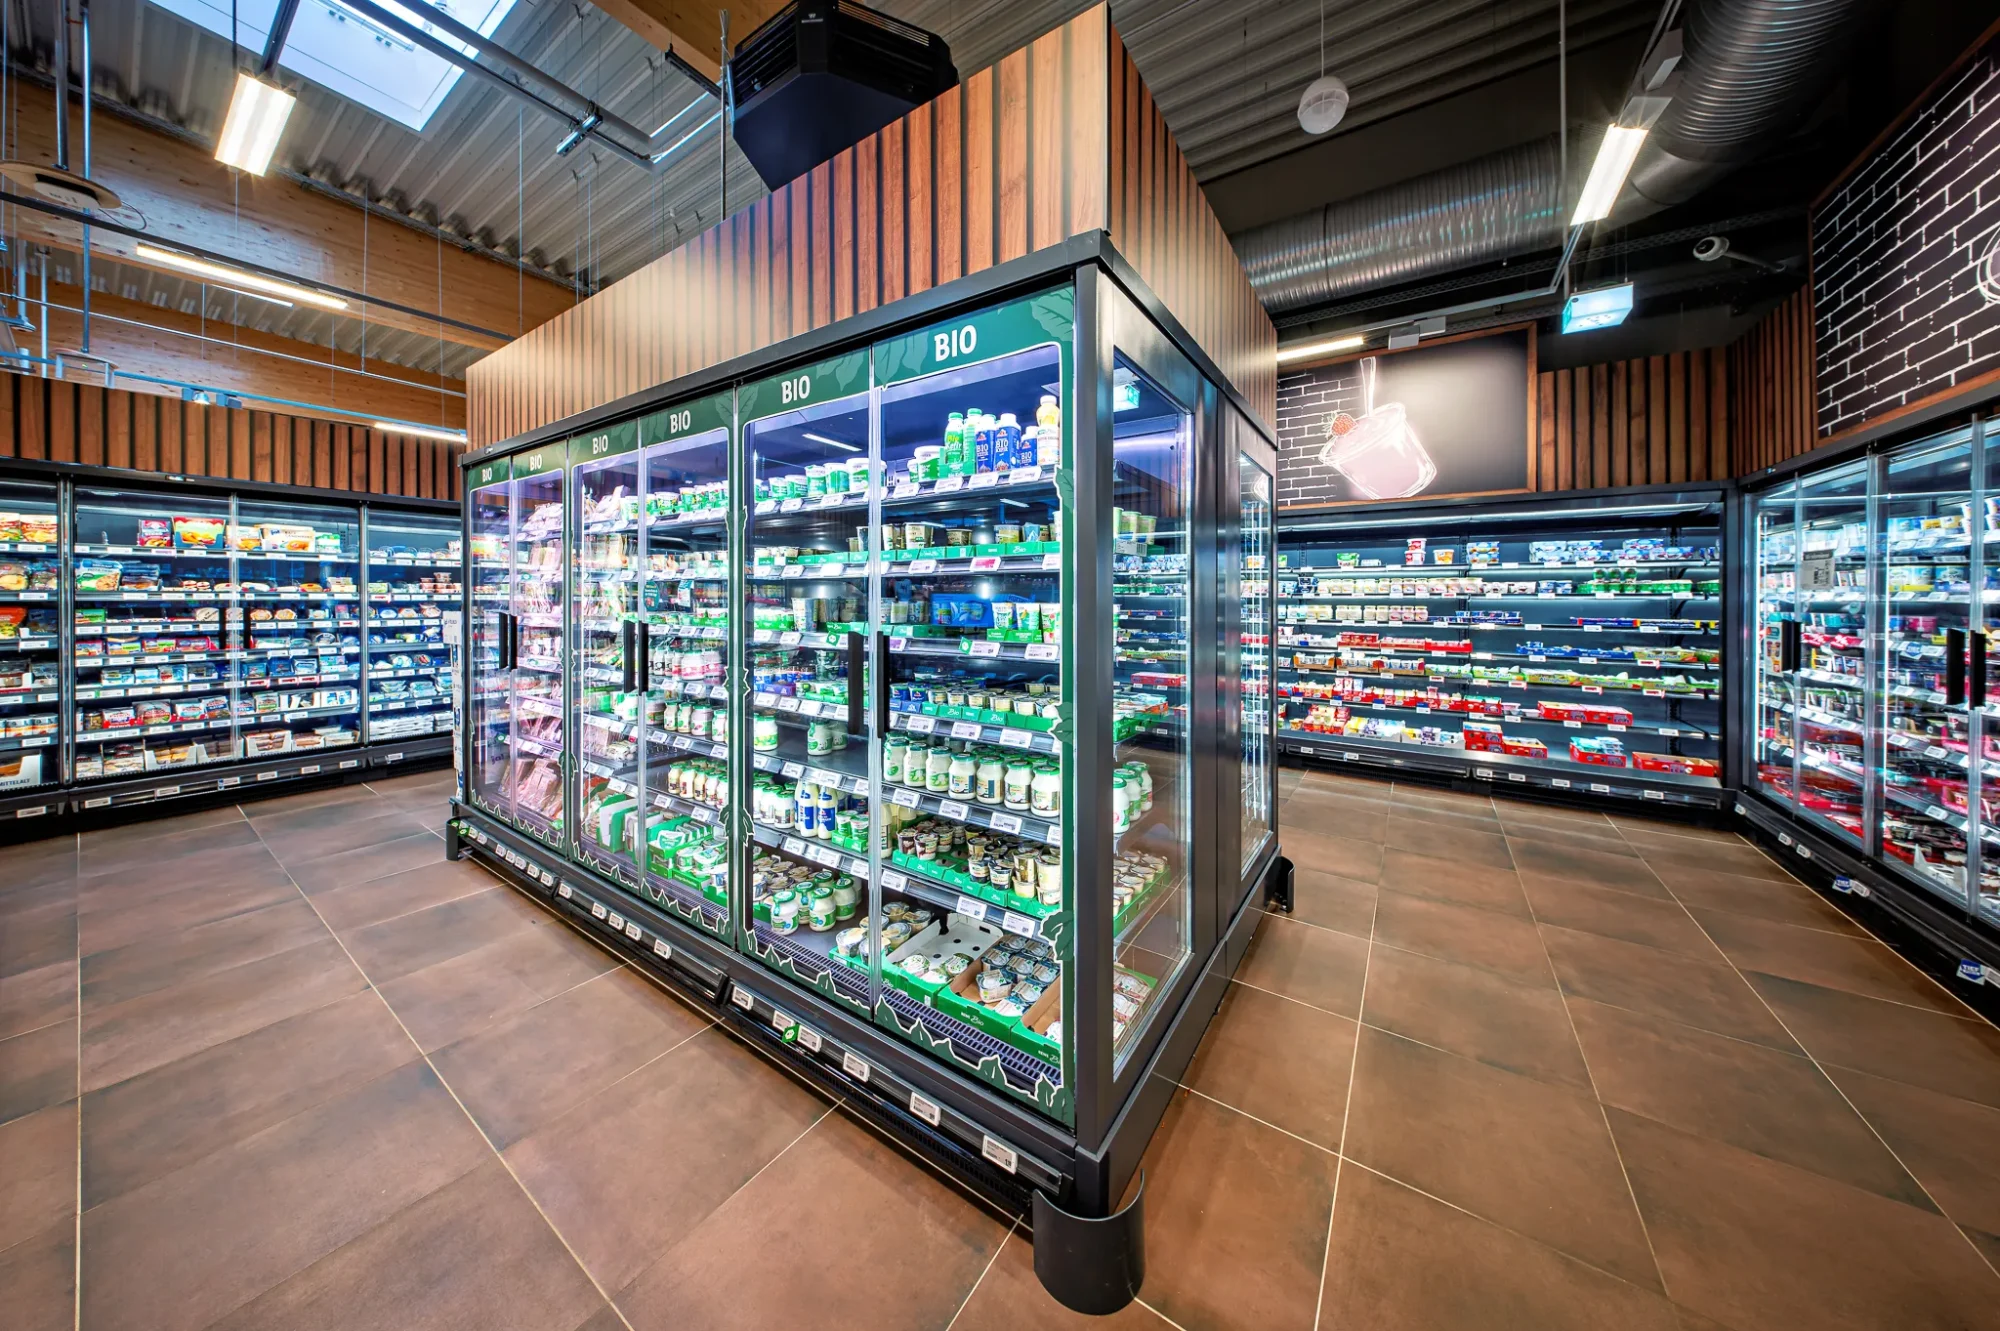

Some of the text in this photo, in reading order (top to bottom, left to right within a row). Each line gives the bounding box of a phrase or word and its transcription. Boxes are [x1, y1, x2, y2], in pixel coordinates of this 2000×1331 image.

[934, 325, 977, 361] BIO
[781, 376, 811, 404] BIO
[670, 410, 691, 434] BIO
[592, 434, 609, 455] BIO
[976, 443, 989, 452] BIO
[996, 439, 1009, 448] BIO
[529, 454, 543, 471] BIO
[481, 468, 493, 482] BIO
[947, 708, 959, 716] Bio
[991, 713, 1004, 722] Bio
[970, 1016, 984, 1026] Bio
